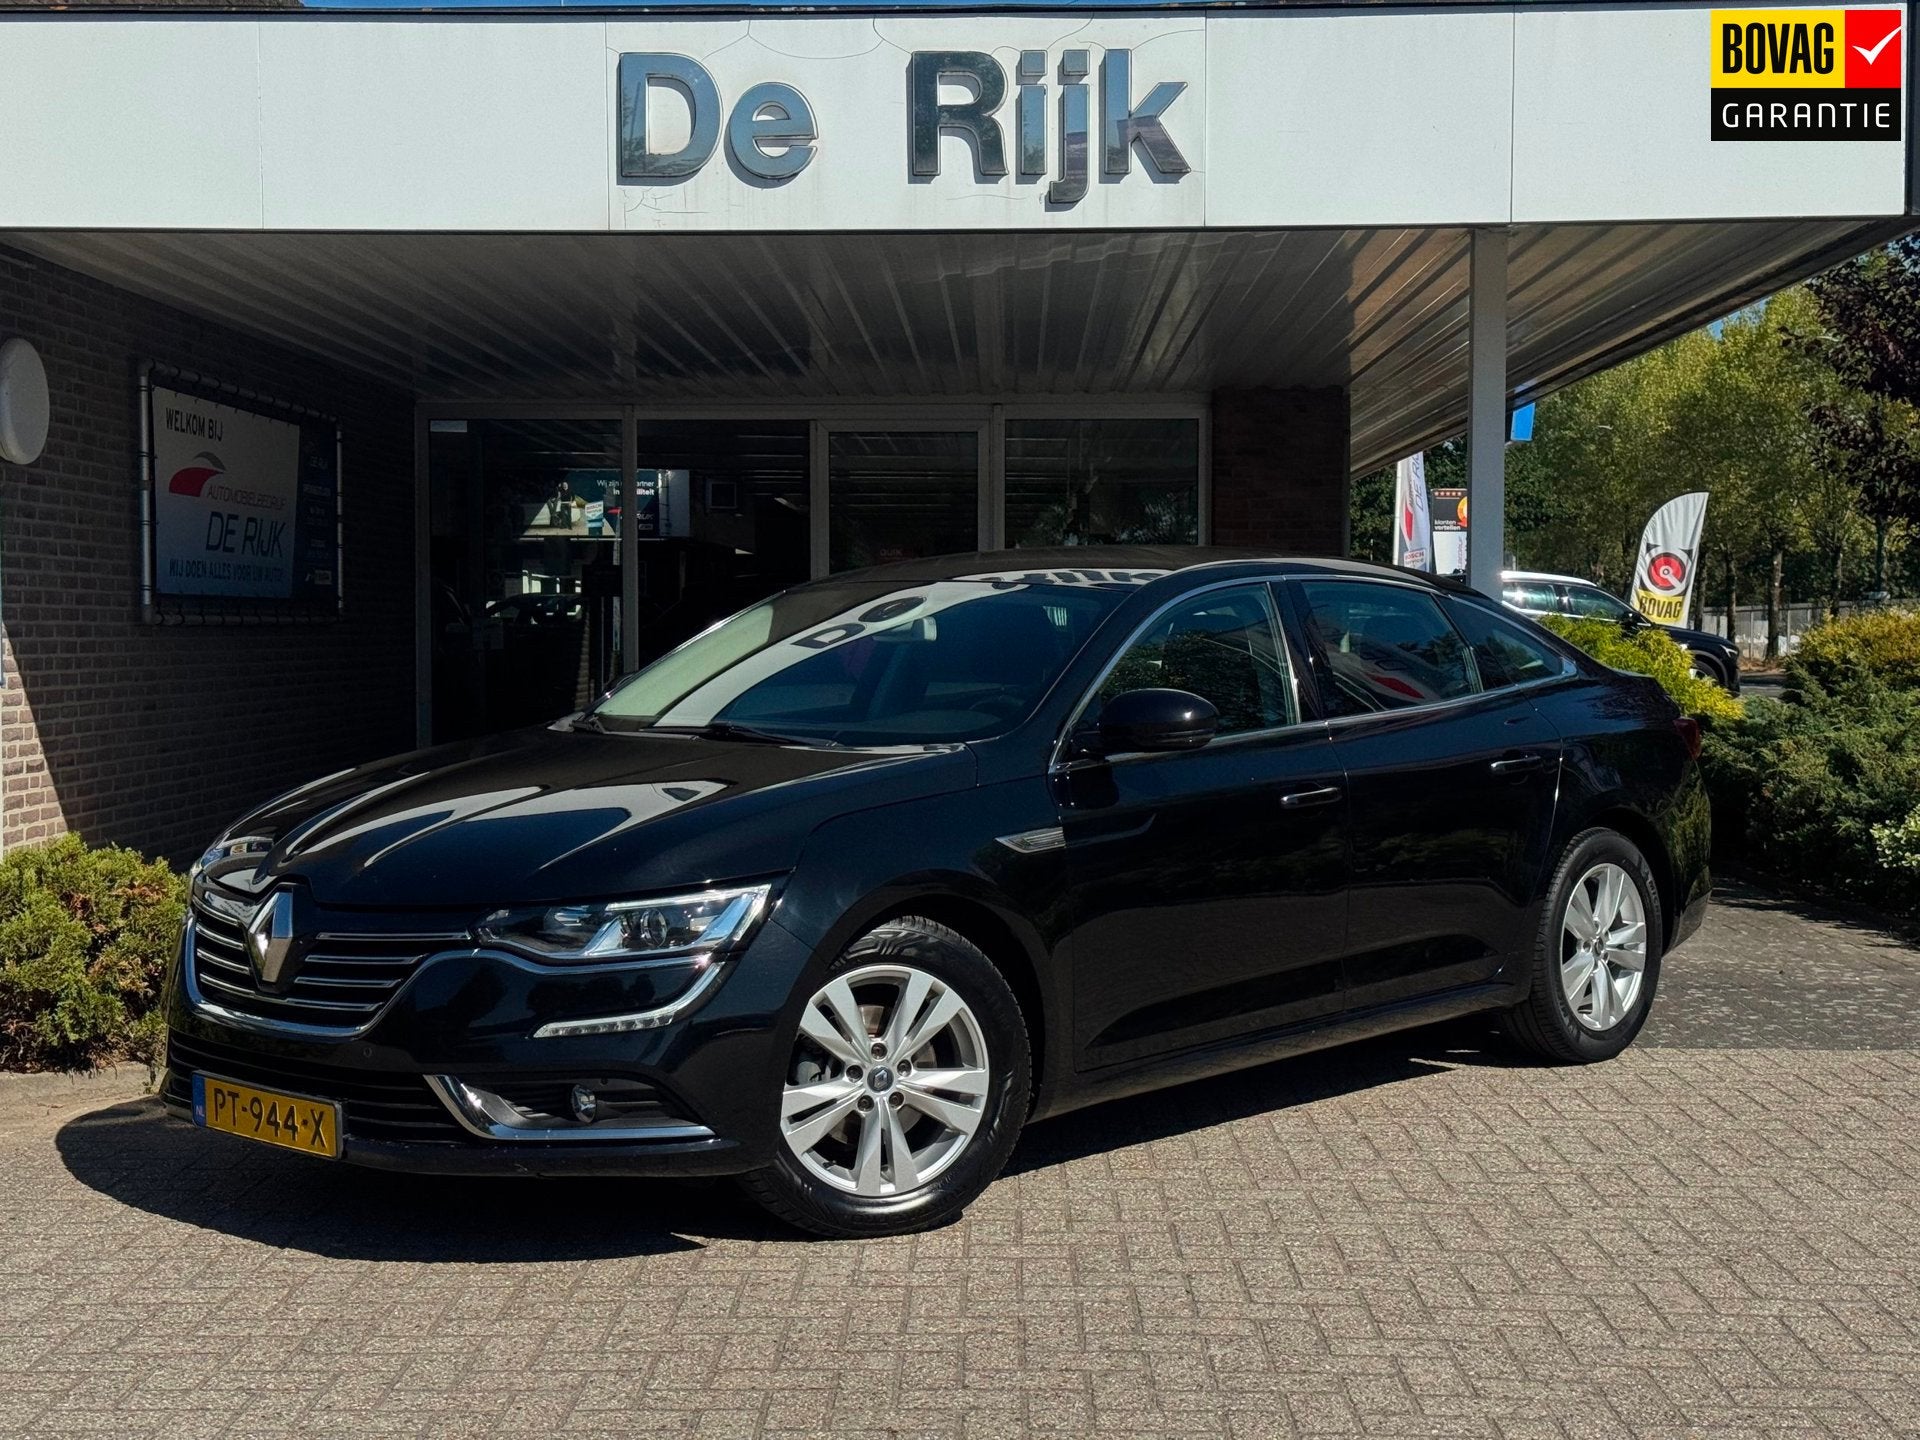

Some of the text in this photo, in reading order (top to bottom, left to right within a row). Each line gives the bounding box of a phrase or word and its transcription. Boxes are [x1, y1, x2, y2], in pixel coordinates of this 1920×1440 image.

[618, 48, 1192, 205] De Rijk
[165, 407, 223, 442] WELKOM BIJ
[206, 511, 287, 558] DE RIJK
[169, 559, 184, 577] WIJ
[185, 560, 207, 578] DOEN
[209, 561, 231, 581] ALLES
[195, 1087, 327, 1148] NL PT-944-X
